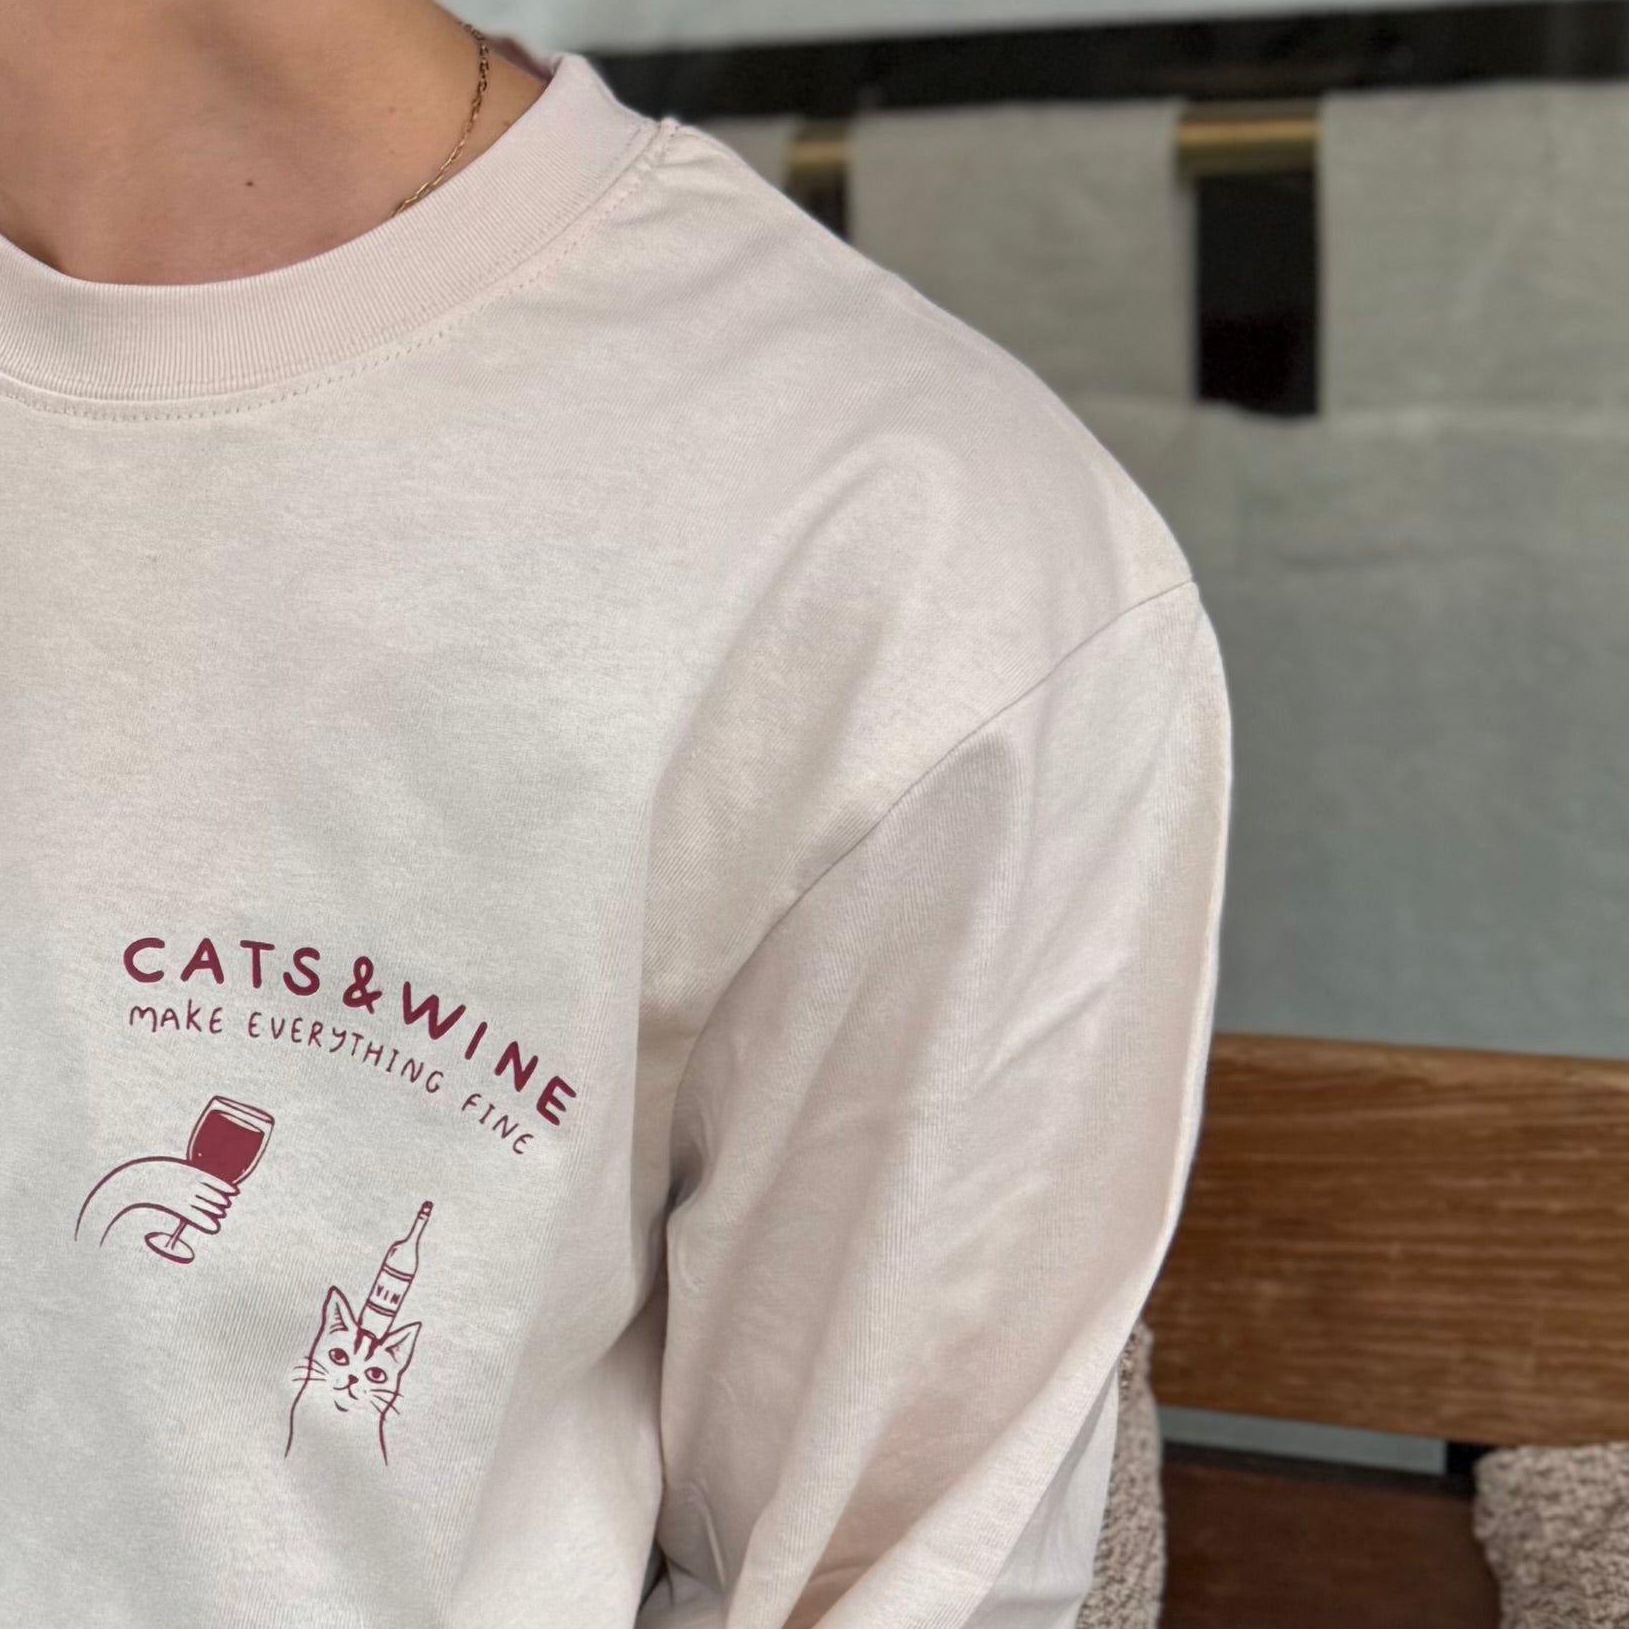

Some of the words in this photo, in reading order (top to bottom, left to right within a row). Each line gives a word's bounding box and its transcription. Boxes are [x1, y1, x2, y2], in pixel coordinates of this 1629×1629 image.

[129, 999, 223, 1034] MAKE
[248, 1012, 445, 1093] EVERYTHING
[462, 1093, 533, 1155] FINE
